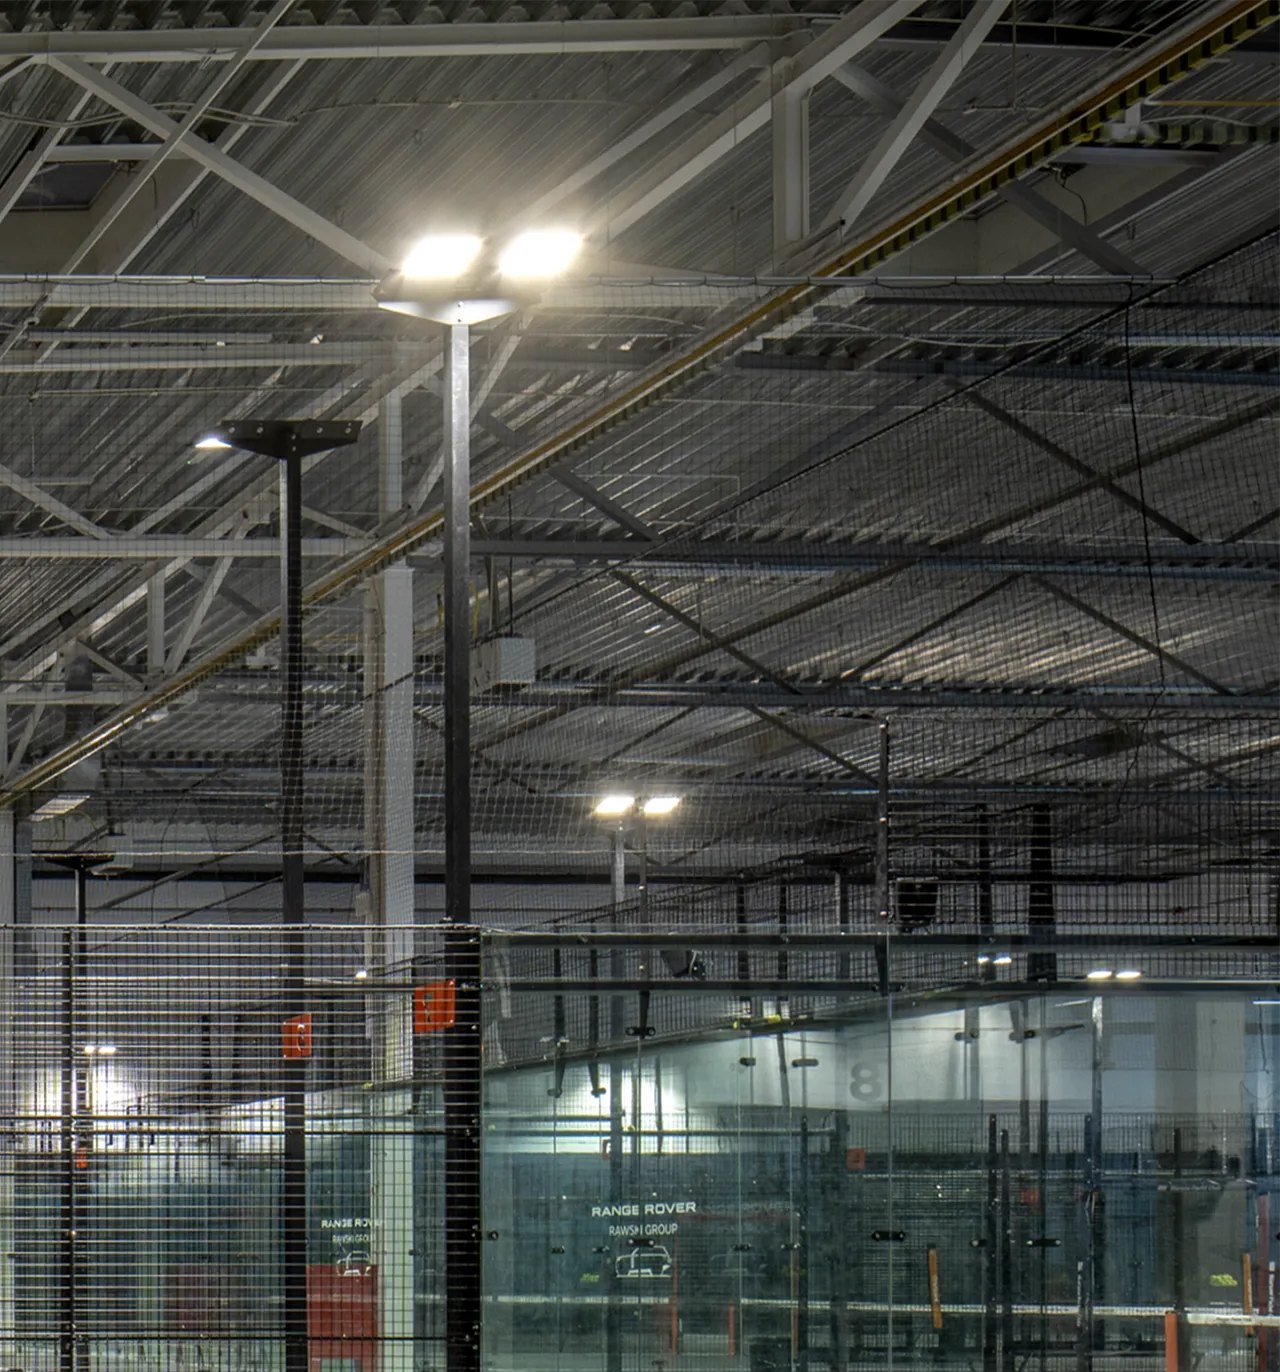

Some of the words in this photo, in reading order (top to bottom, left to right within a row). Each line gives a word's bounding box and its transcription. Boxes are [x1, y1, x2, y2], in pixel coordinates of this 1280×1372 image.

[850, 1062, 882, 1101] 8
[592, 1205, 639, 1217] RANGE
[645, 1202, 696, 1214] ROVER
[645, 1223, 678, 1236] GROUP
